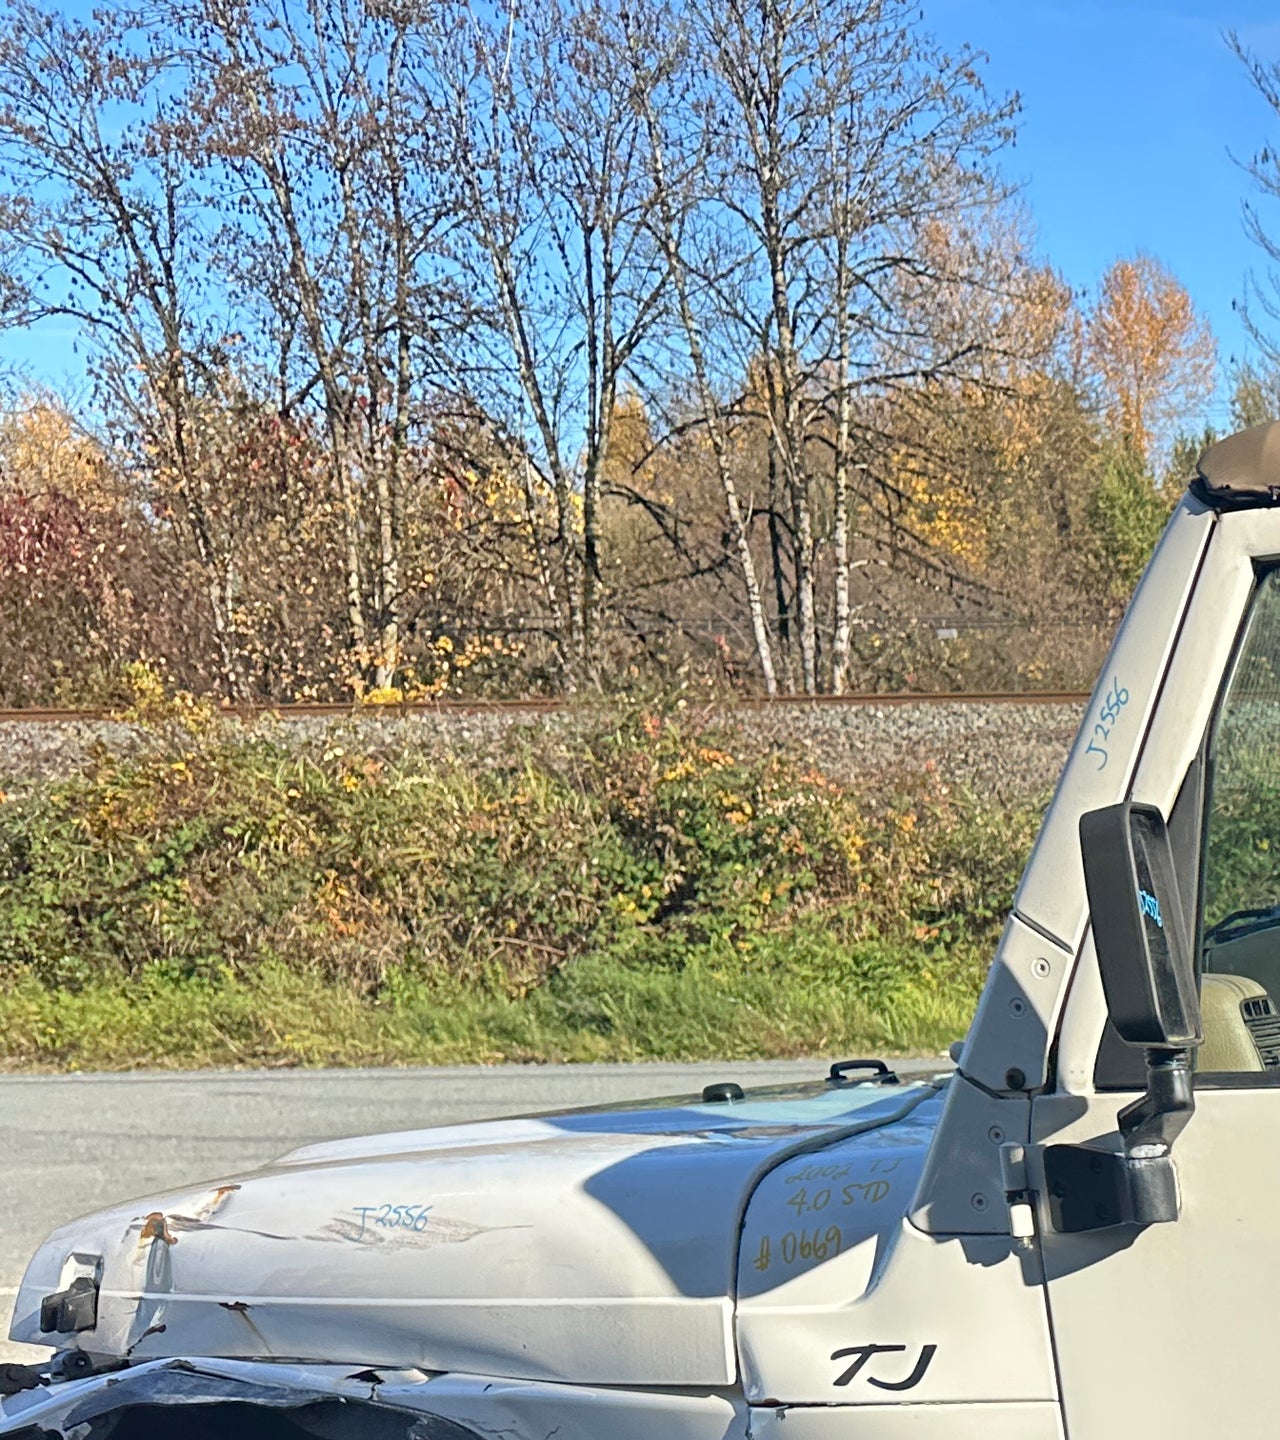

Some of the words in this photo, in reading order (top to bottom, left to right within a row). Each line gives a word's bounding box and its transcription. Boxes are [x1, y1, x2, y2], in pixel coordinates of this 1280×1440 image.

[1085, 676, 1130, 771] J2556
[785, 1162, 854, 1184] 2002
[869, 1155, 913, 1174] TJ
[786, 1187, 832, 1217] 4.0
[841, 1179, 891, 1207] STD
[345, 1203, 434, 1242] J2556
[830, 1343, 938, 1392] TJ
